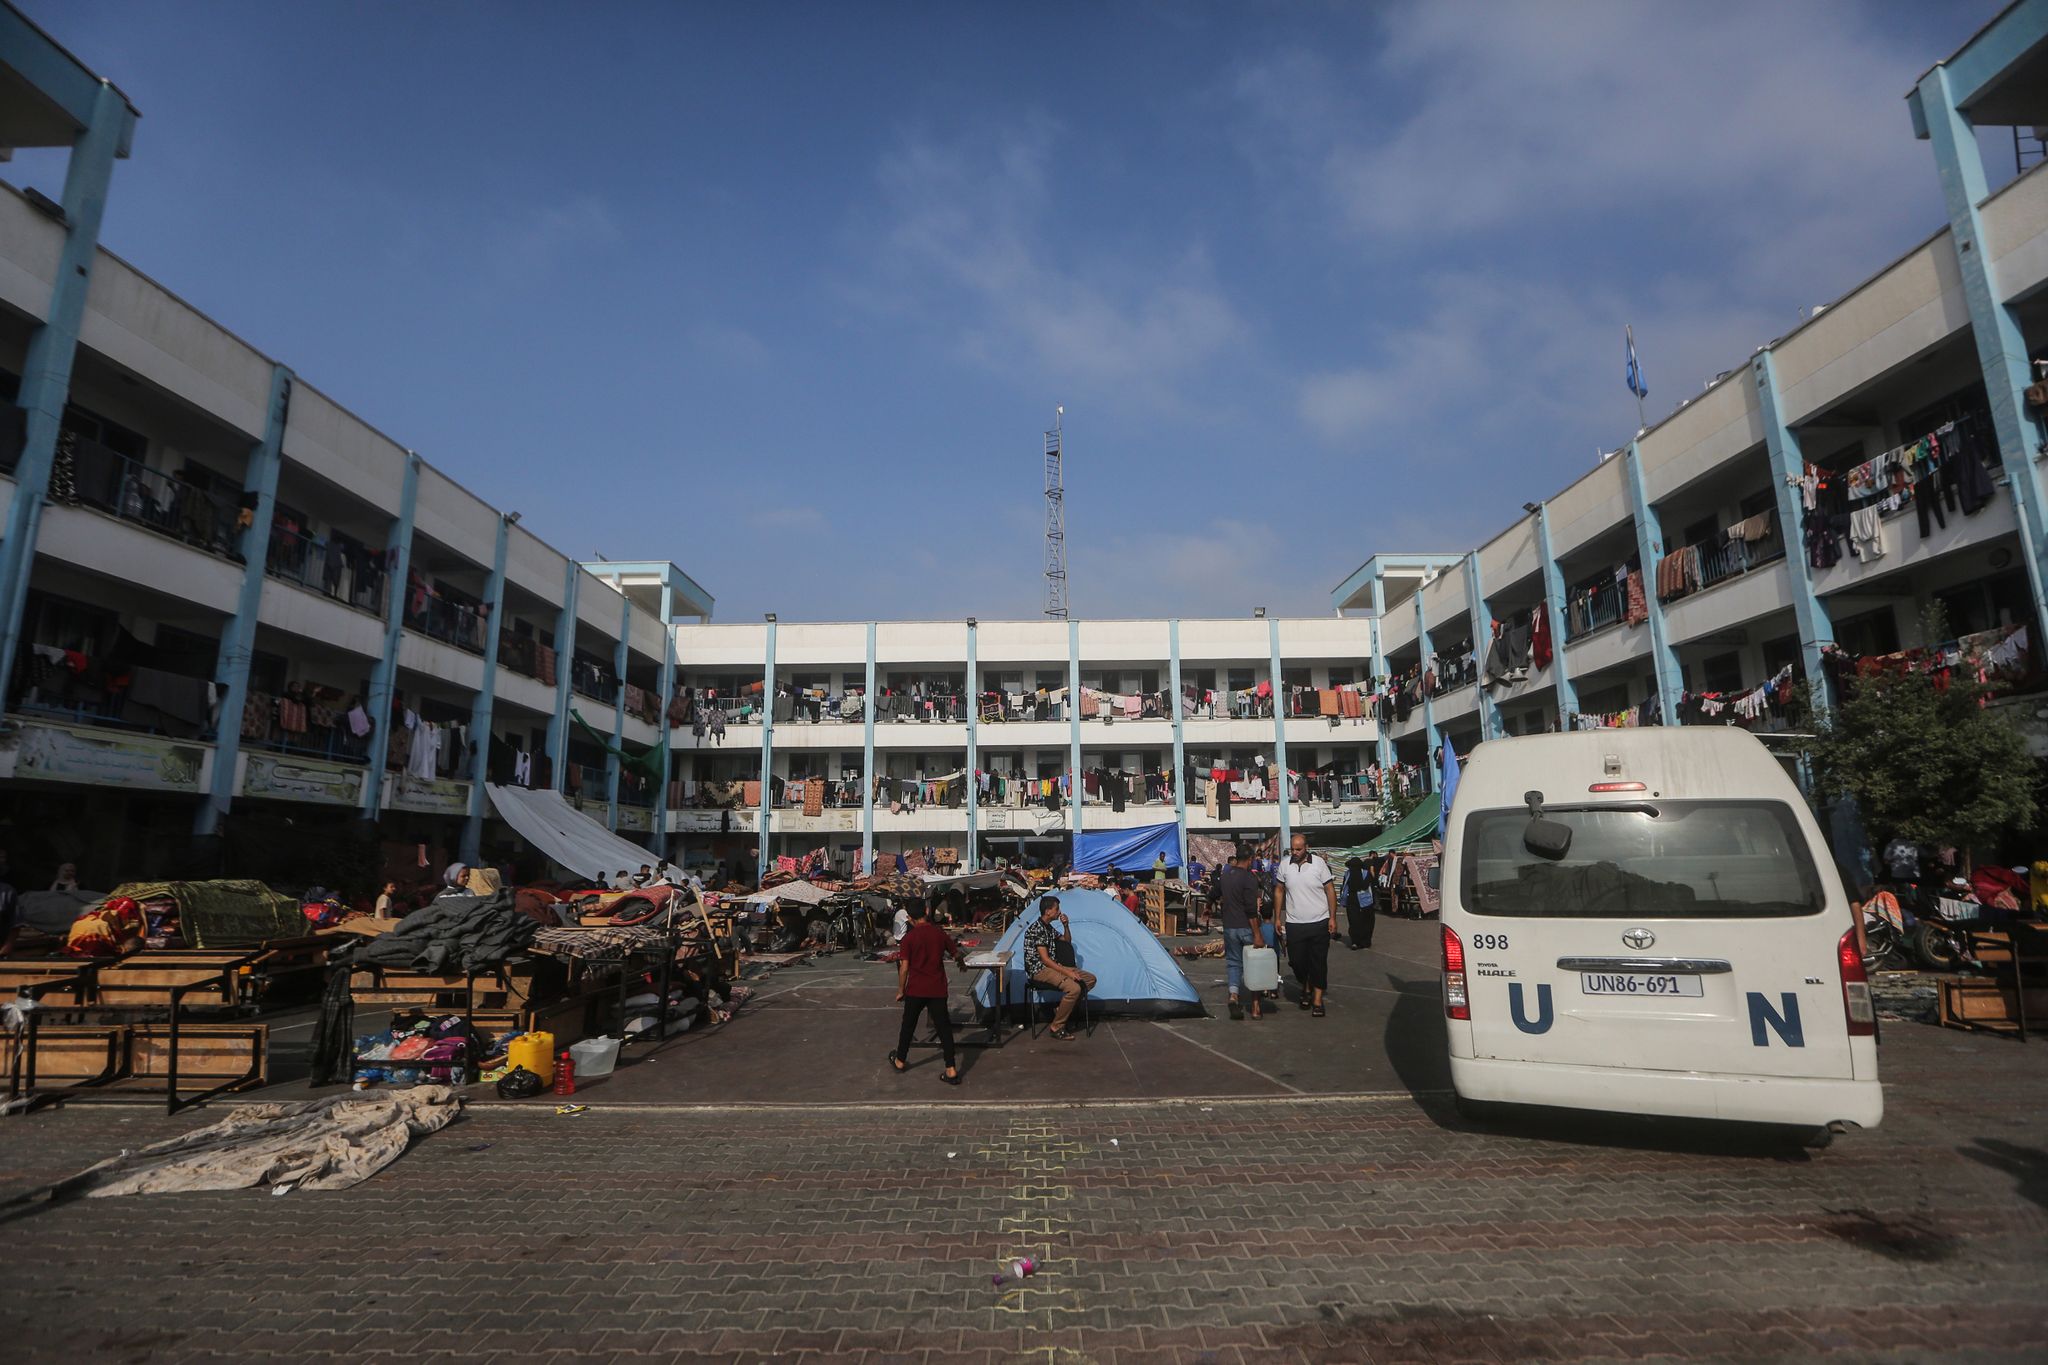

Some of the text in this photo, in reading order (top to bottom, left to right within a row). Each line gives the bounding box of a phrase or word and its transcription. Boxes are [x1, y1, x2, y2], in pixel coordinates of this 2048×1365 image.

[1473, 934, 1509, 950] 898
[1477, 969, 1516, 977] HIACE
[1588, 975, 1680, 994] UN86-691
[1508, 983, 1805, 1047] U N
